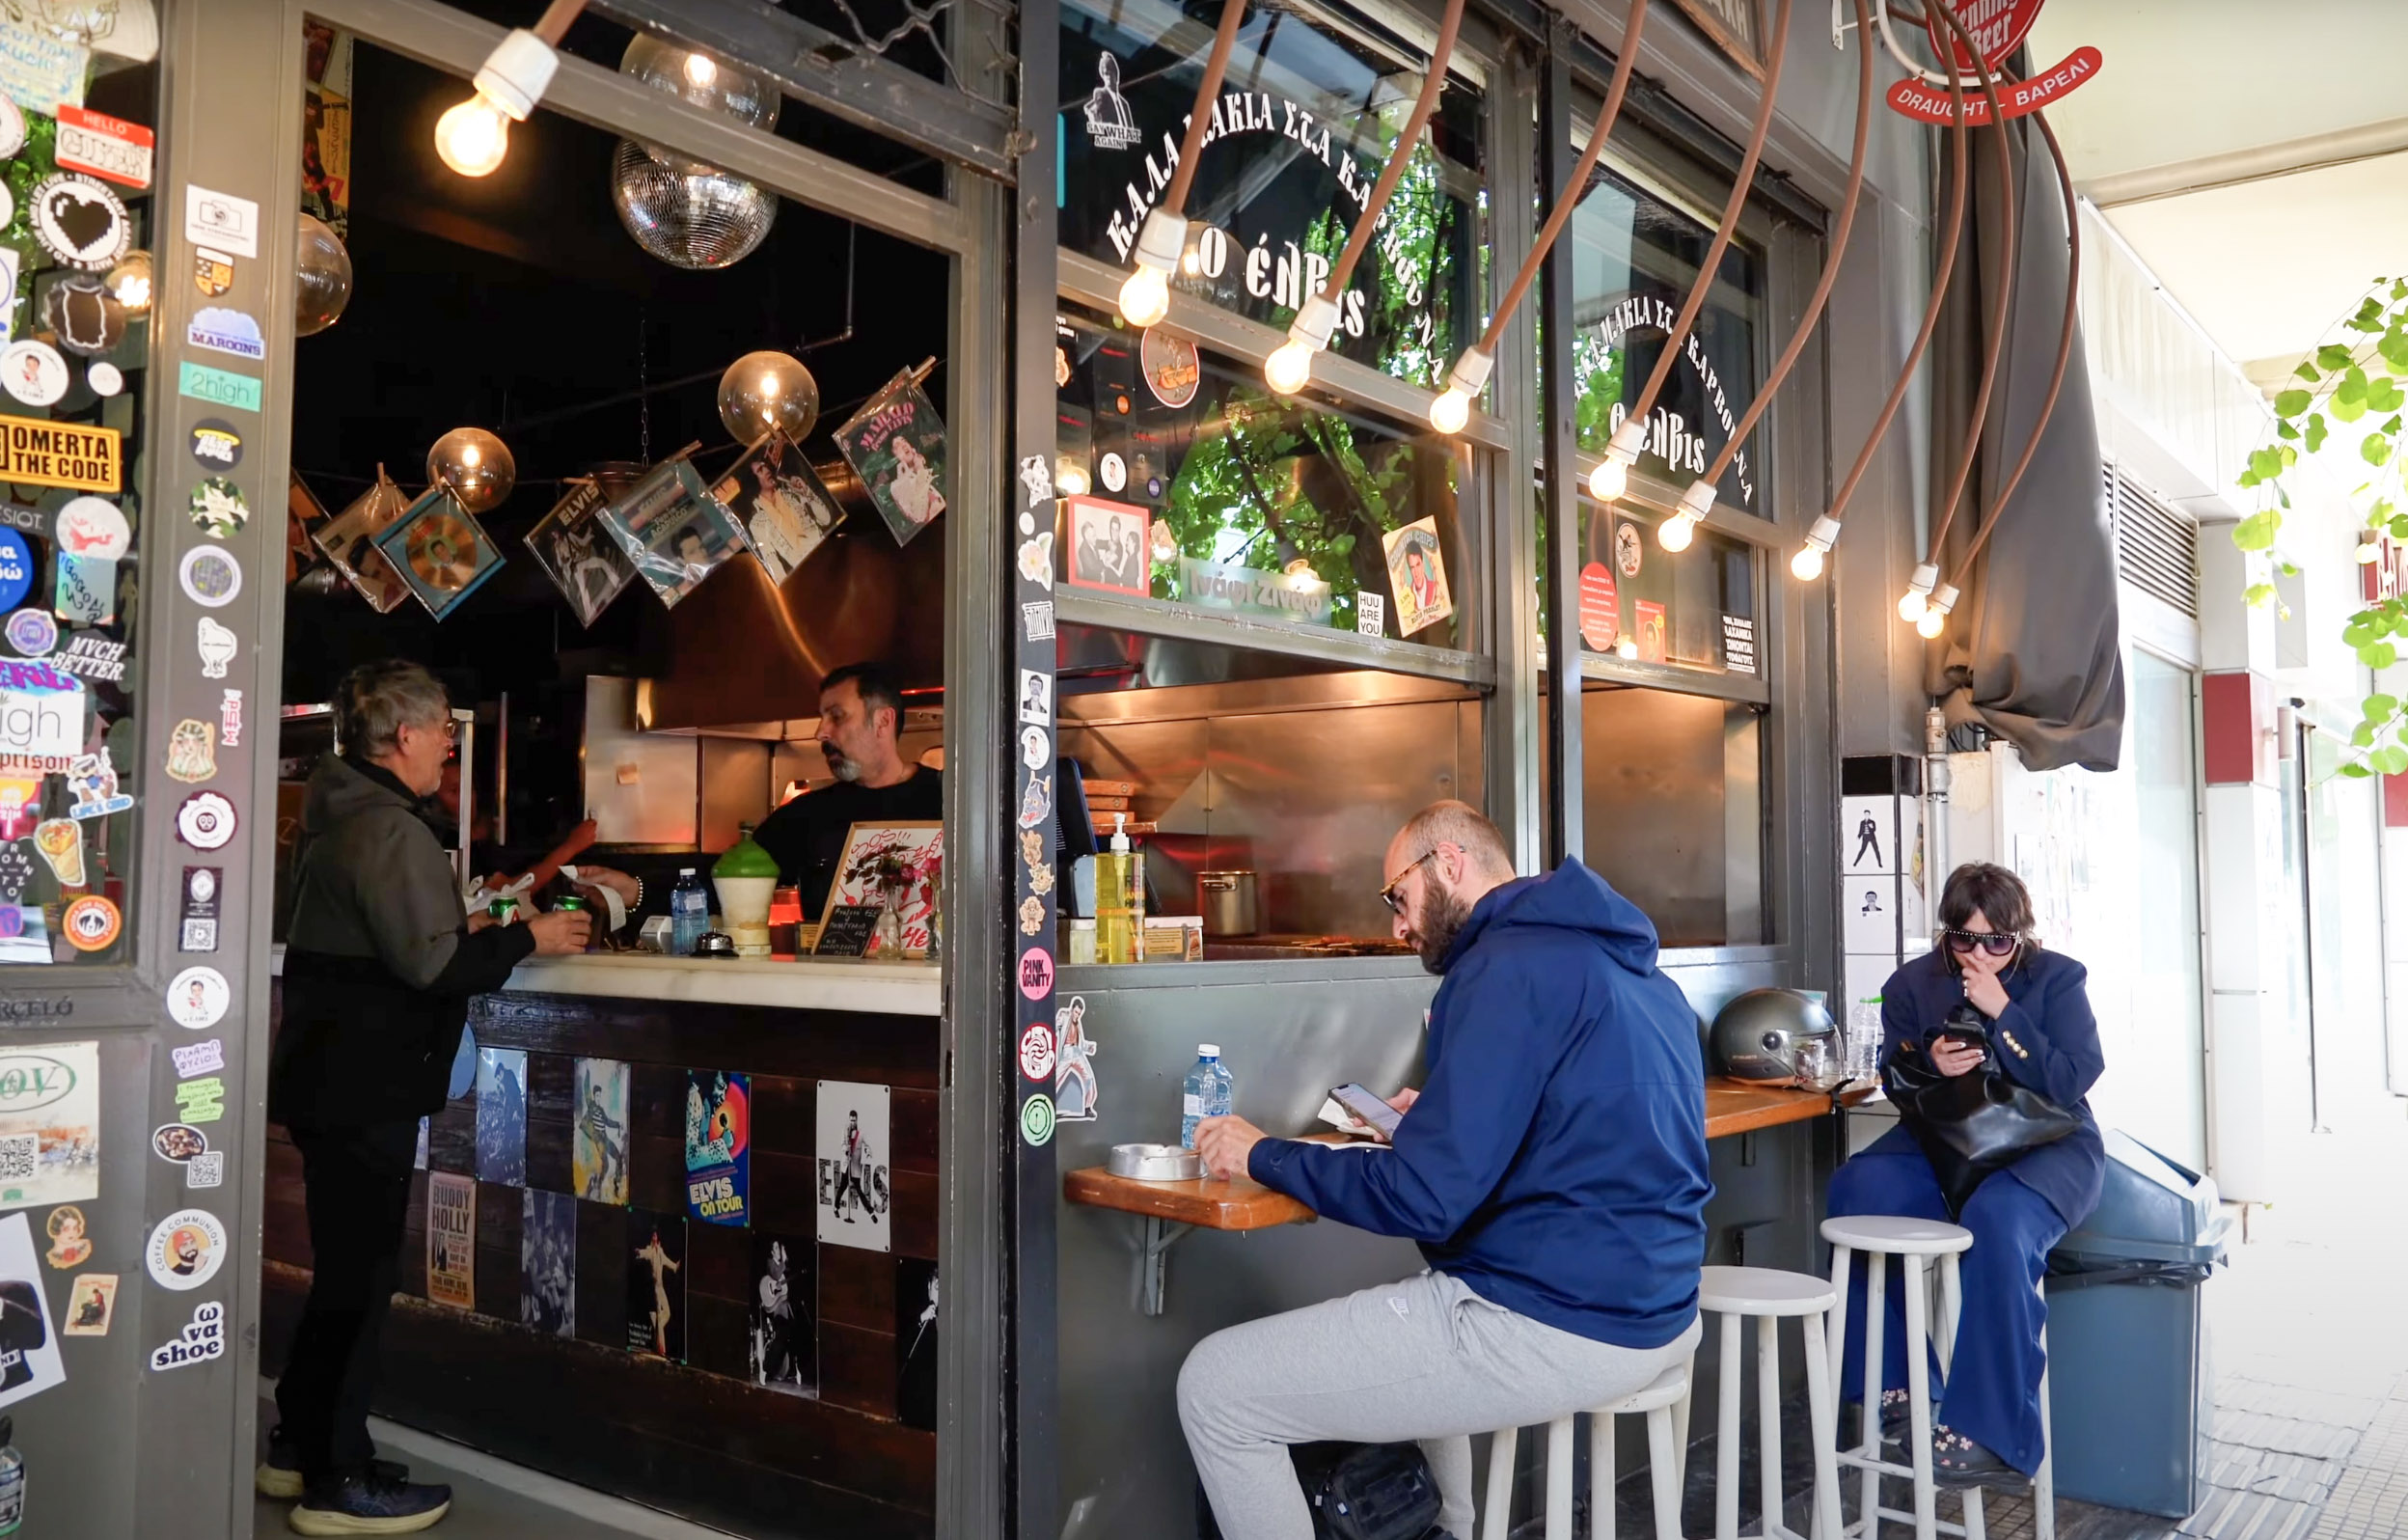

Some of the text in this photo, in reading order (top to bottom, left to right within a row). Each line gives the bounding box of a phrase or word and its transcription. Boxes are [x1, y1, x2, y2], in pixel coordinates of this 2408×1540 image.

[2015, 58, 2091, 107] ΒΑΡΕΛΙ
[83, 113, 126, 134] HELLO
[1087, 123, 1141, 143] SAY WHAT
[1283, 99, 1330, 167] ΣΤΑ
[1656, 299, 1683, 346] ΣΤ
[192, 332, 261, 356] MAROONS
[191, 371, 250, 404] 2high
[13, 426, 110, 460] OMERTA
[13, 452, 110, 482] THE CODE
[558, 483, 600, 527] ELVIS
[1360, 594, 1380, 608] HUU
[1360, 609, 1380, 621] ARE
[1360, 622, 1380, 635] YOU
[67, 637, 126, 662] MVCH
[1024, 959, 1044, 974] PINK
[1023, 974, 1051, 987] VANITY
[433, 1185, 470, 1210] BUDDY
[689, 1176, 733, 1204] ELVIS
[819, 1158, 889, 1214] ELIS
[715, 1196, 743, 1214] TOUR
[432, 1206, 470, 1234] HOLLY
[154, 1216, 219, 1272] COFFEE COMMUNION
[155, 1340, 220, 1366] shoe
